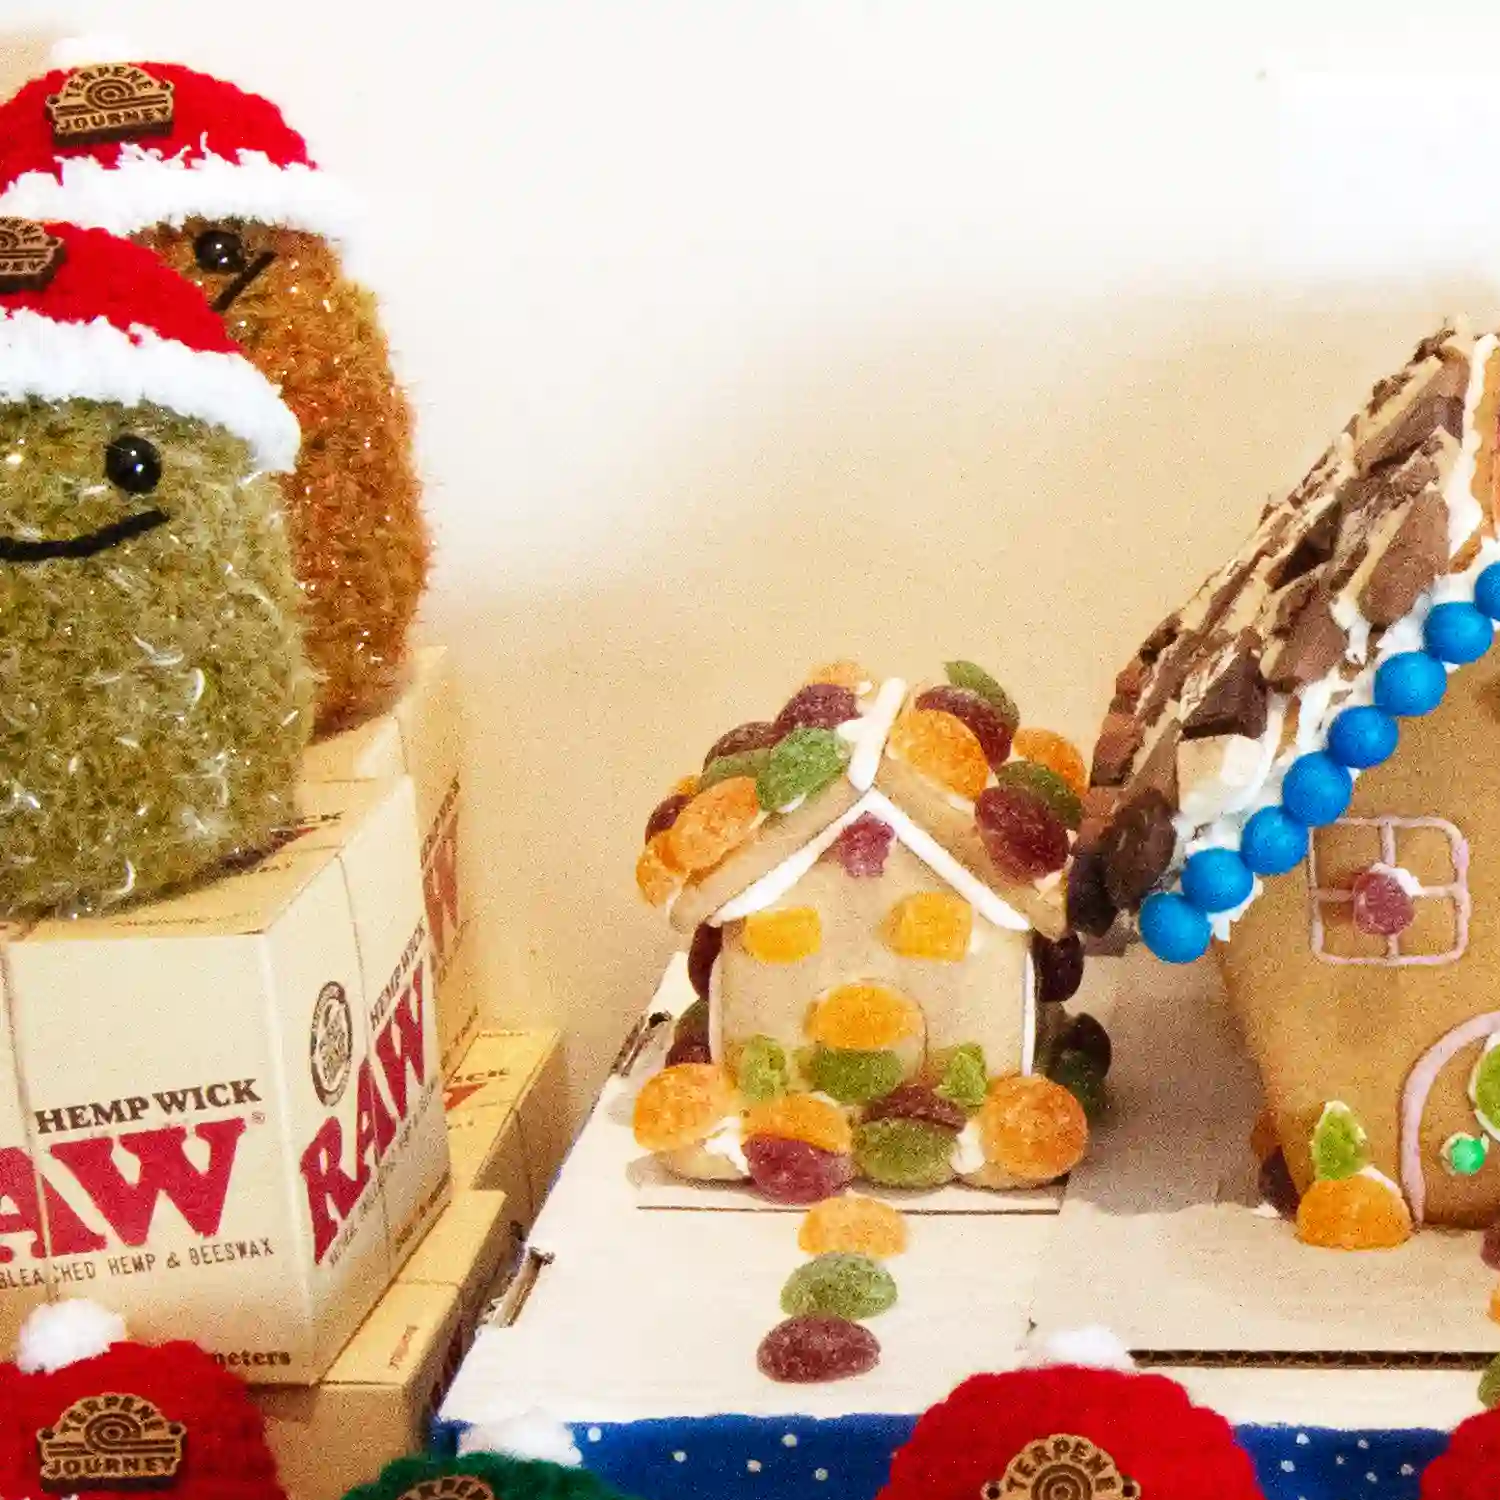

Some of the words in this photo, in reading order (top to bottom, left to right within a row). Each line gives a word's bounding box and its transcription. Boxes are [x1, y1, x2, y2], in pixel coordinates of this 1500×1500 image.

[64, 66, 153, 99] TERPENE
[59, 106, 169, 131] JOURNEY
[34, 1096, 150, 1134] HEMP
[152, 1079, 263, 1114] WICK
[300, 960, 425, 1266] RAW
[0, 1117, 247, 1264] AW
[109, 1254, 156, 1276] HEMP
[166, 1251, 181, 1270] &
[190, 1236, 275, 1265] BEESWAX
[50, 1456, 175, 1475] JOURNEY
[1006, 1439, 1117, 1492] TERPENE
